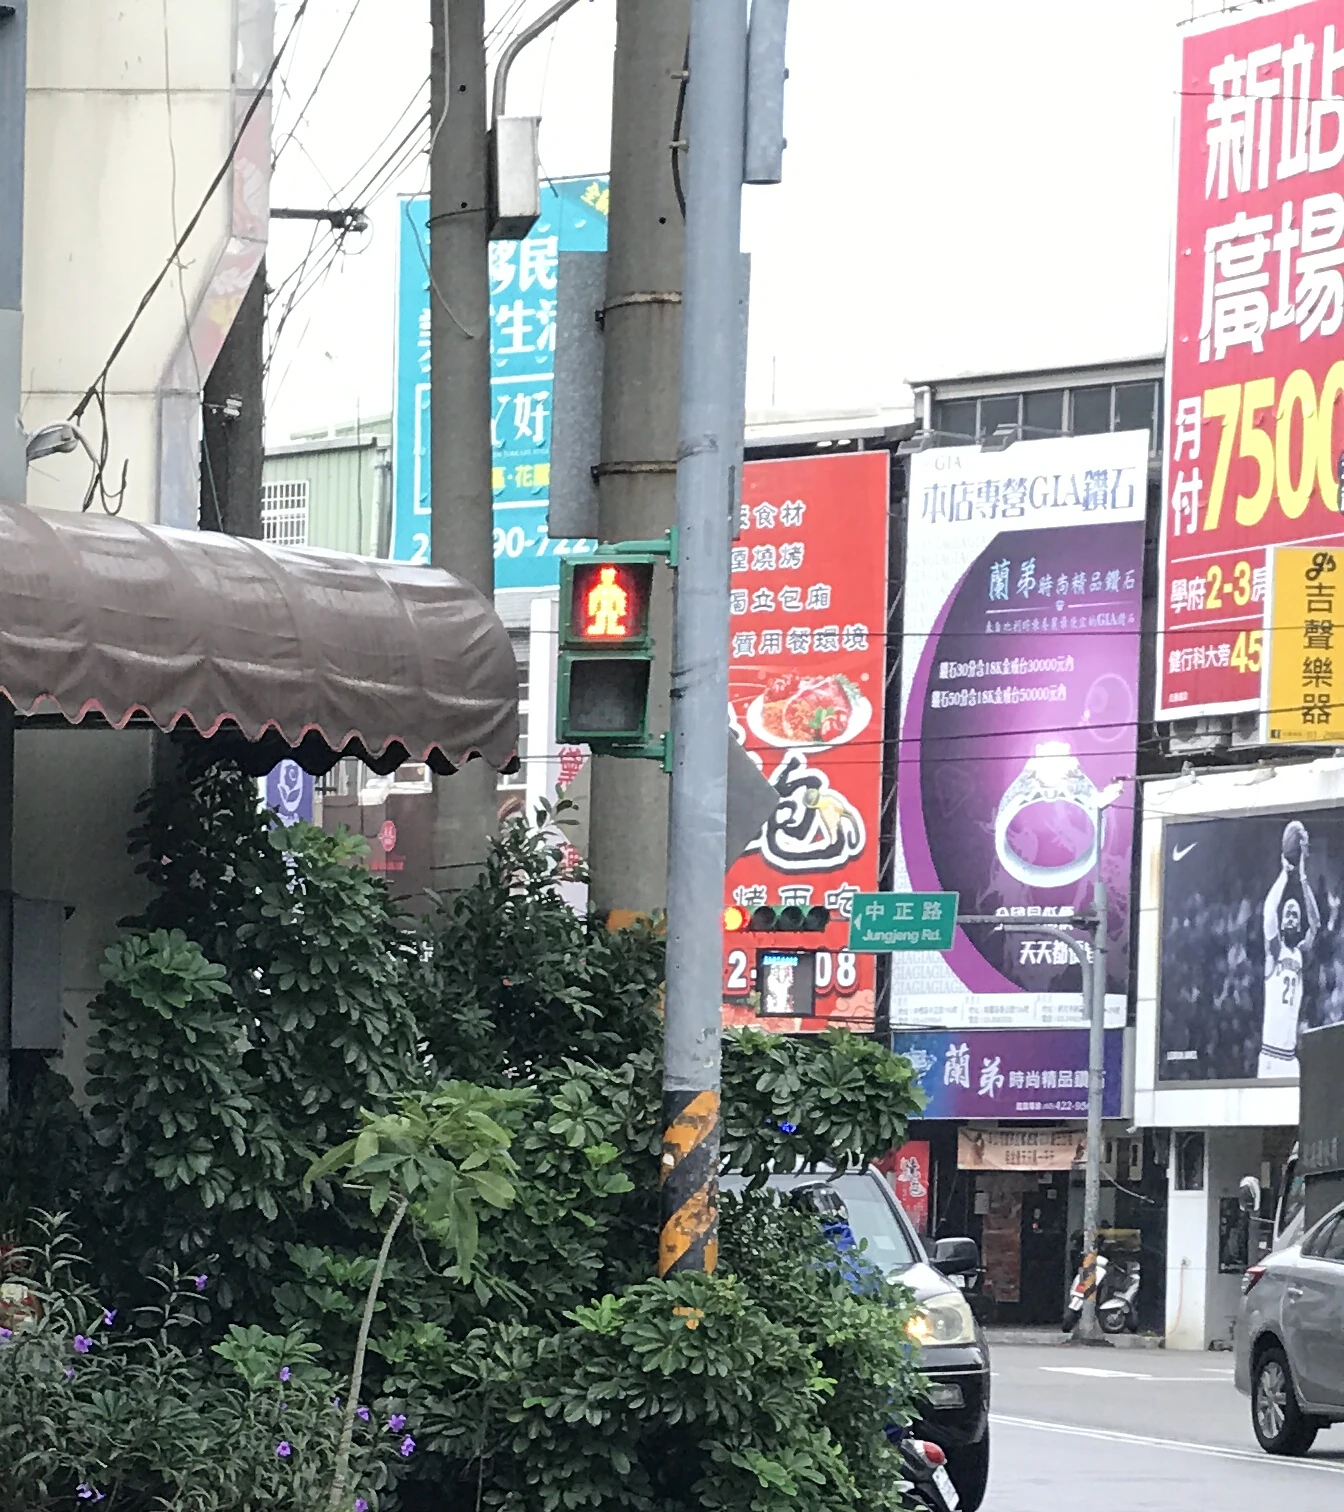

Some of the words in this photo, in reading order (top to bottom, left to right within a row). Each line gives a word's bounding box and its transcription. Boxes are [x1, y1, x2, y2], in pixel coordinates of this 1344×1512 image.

[1205, 24, 1344, 200] 新站
[1199, 193, 1344, 363] 廣場
[921, 466, 1137, 524] 本店專營GIA鑽石
[1172, 396, 1203, 537] 月付
[1301, 582, 1336, 725] 吉聲樂器
[862, 929, 919, 943] Jungjeng
[921, 928, 942, 941] Rd.
[865, 901, 943, 921] 中正路
